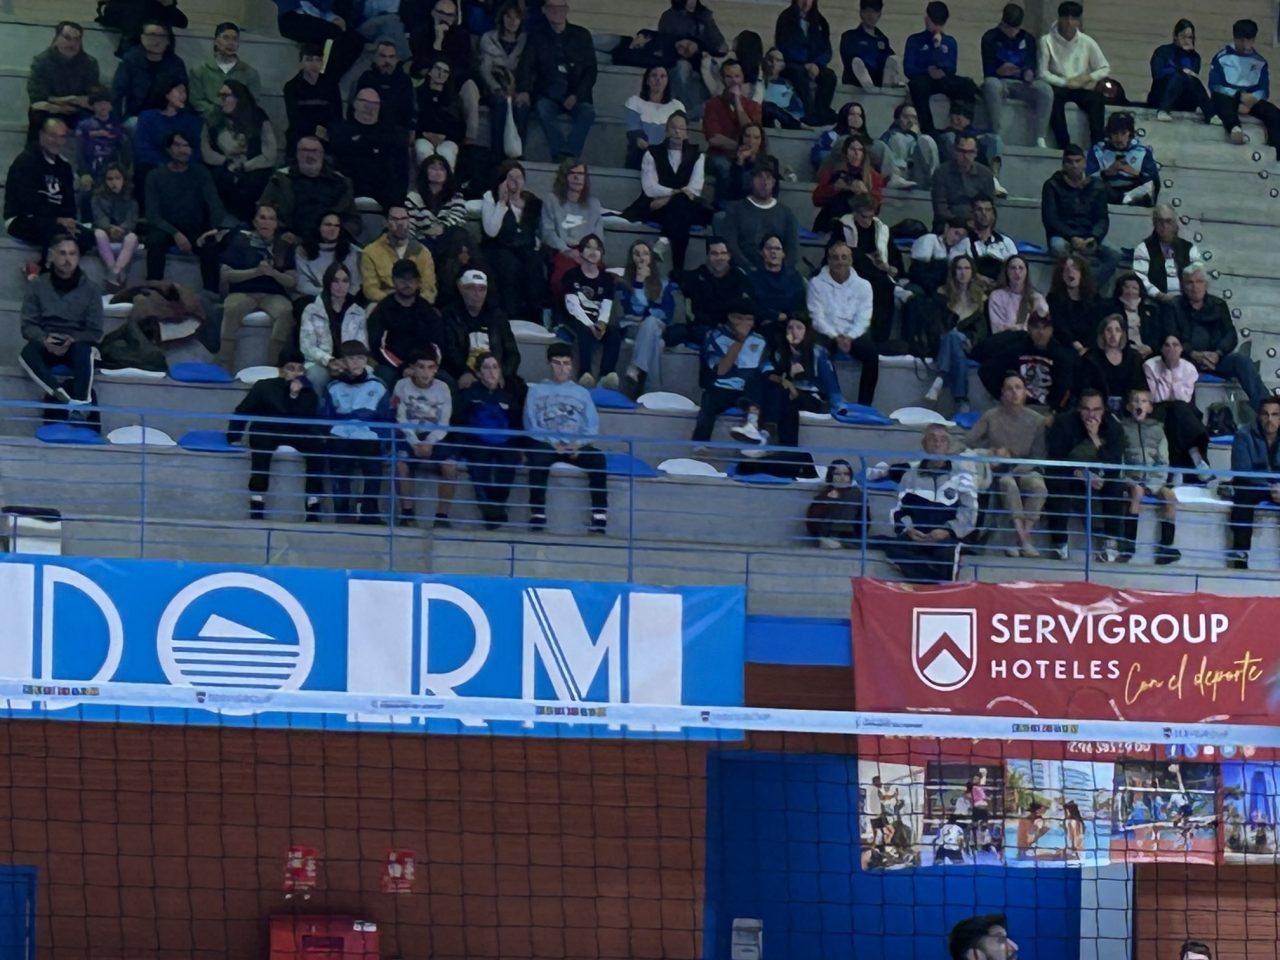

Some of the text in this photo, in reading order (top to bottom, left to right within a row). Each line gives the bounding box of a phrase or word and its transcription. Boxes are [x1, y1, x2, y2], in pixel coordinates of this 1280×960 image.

[990, 612, 1229, 645] SERVIGROUP
[990, 660, 1120, 680] HOTELES
[1125, 651, 1264, 705] Con el deporte
